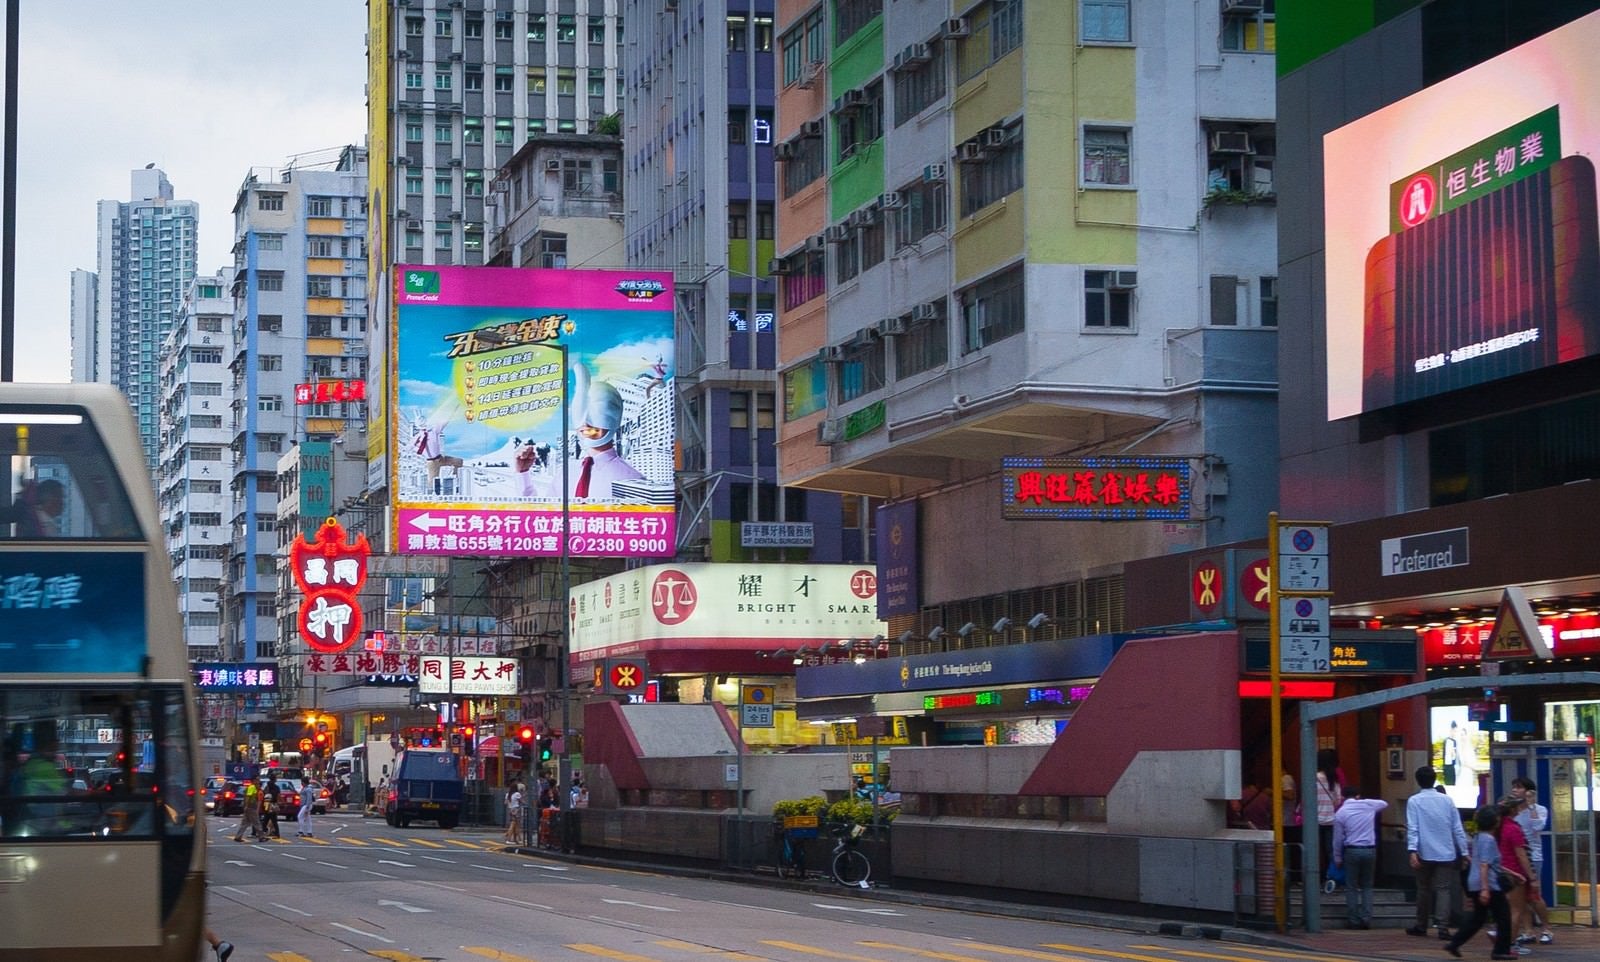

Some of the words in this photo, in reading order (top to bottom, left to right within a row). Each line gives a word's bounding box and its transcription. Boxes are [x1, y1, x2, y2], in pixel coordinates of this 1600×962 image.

[1446, 132, 1544, 200] 恒生物業
[301, 456, 329, 472] SING
[1015, 470, 1181, 506] 興旺麻雀娛樂
[588, 538, 625, 553] 2380
[629, 539, 667, 553] 9900
[1311, 558, 1320, 569] 7
[1391, 544, 1453, 574] Preferred
[738, 574, 817, 598] 耀才
[1311, 576, 1320, 588] 7
[738, 604, 797, 613] BRIGHT
[828, 605, 881, 614] SMAR
[307, 597, 352, 643] 押
[1311, 639, 1321, 651] 7
[422, 659, 515, 682] 同昌大押
[1312, 659, 1328, 671] 12
[444, 683, 472, 691] CEONG
